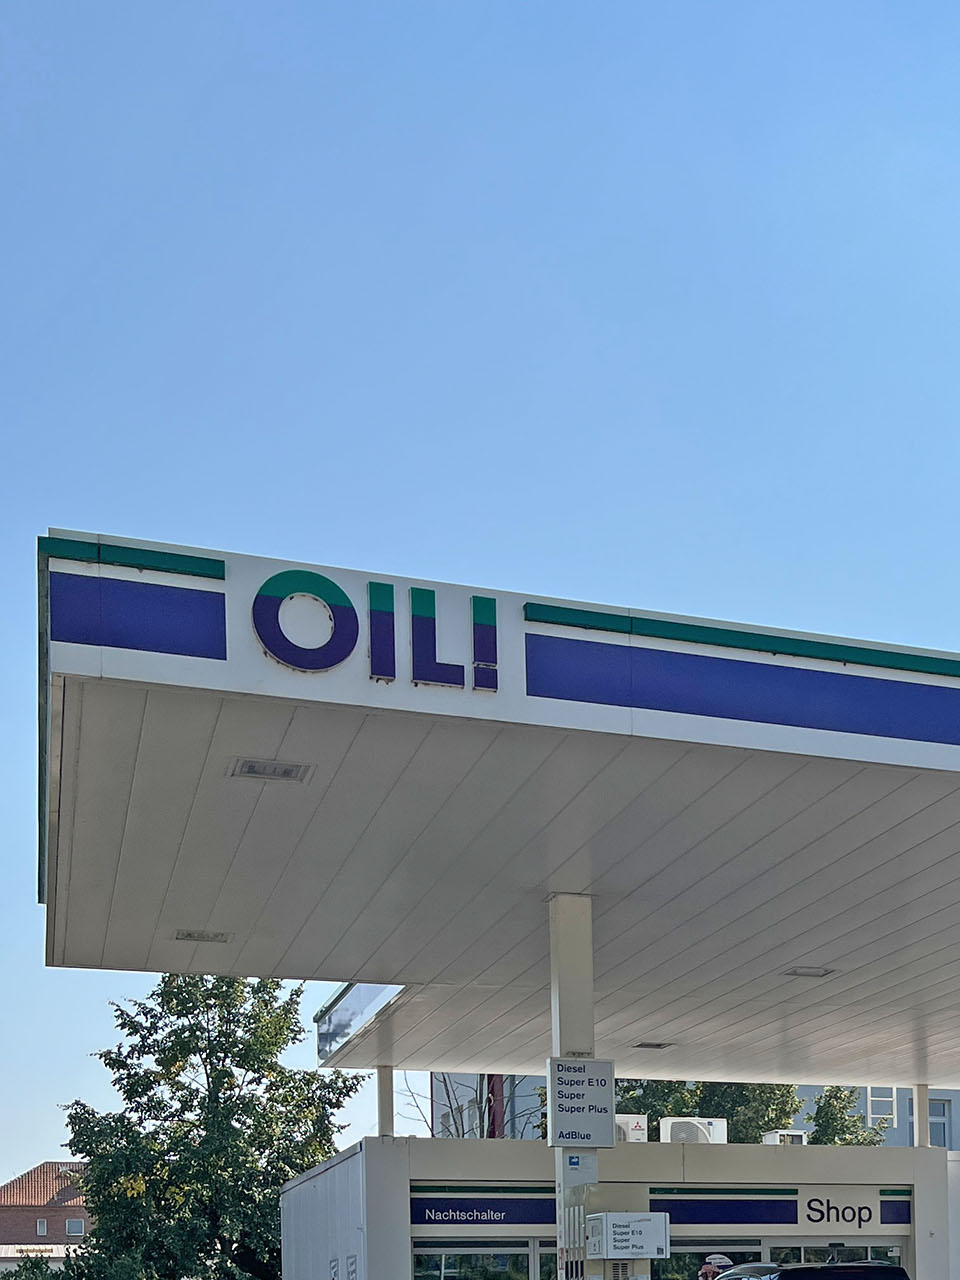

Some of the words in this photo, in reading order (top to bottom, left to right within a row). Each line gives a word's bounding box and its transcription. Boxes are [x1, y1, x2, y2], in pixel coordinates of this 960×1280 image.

[252, 569, 498, 693] OIL!
[557, 1063, 586, 1073] Diesel
[557, 1077, 585, 1088] Super
[588, 1078, 607, 1087] E10
[557, 1090, 585, 1100] Super
[557, 1103, 586, 1114] Super
[588, 1104, 609, 1114] Plus
[558, 1130, 592, 1140] AdBlue
[425, 1208, 506, 1220] Nachtschalter
[806, 1198, 873, 1229] Shop
